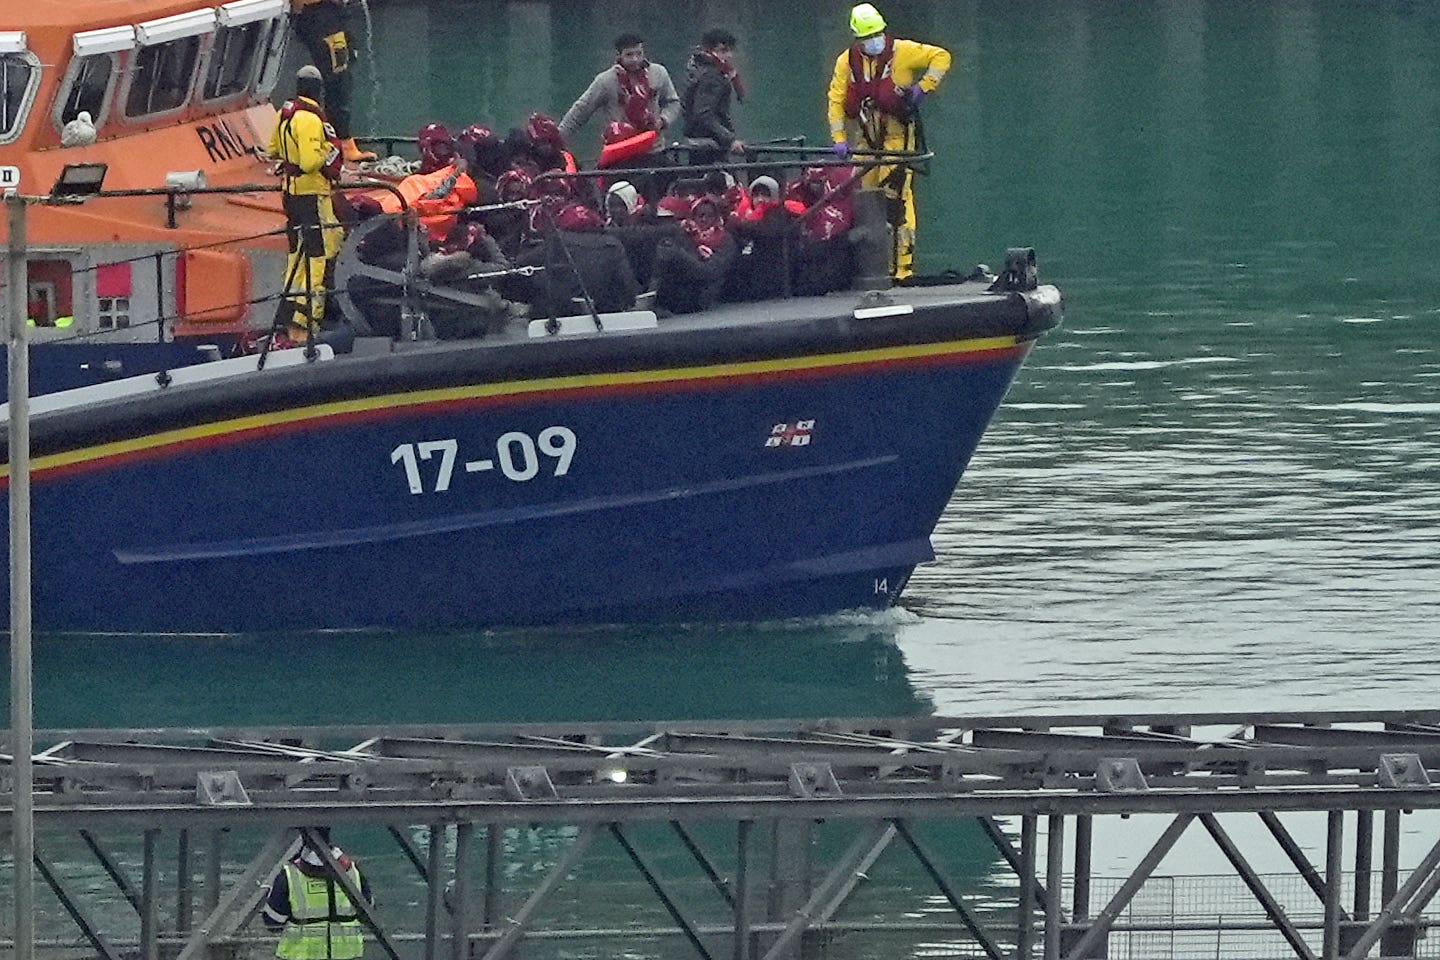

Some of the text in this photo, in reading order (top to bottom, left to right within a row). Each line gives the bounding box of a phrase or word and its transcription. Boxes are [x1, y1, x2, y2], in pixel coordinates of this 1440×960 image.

[2, 170, 13, 183] II
[390, 425, 577, 495] 17-09
[874, 578, 888, 594] 14
